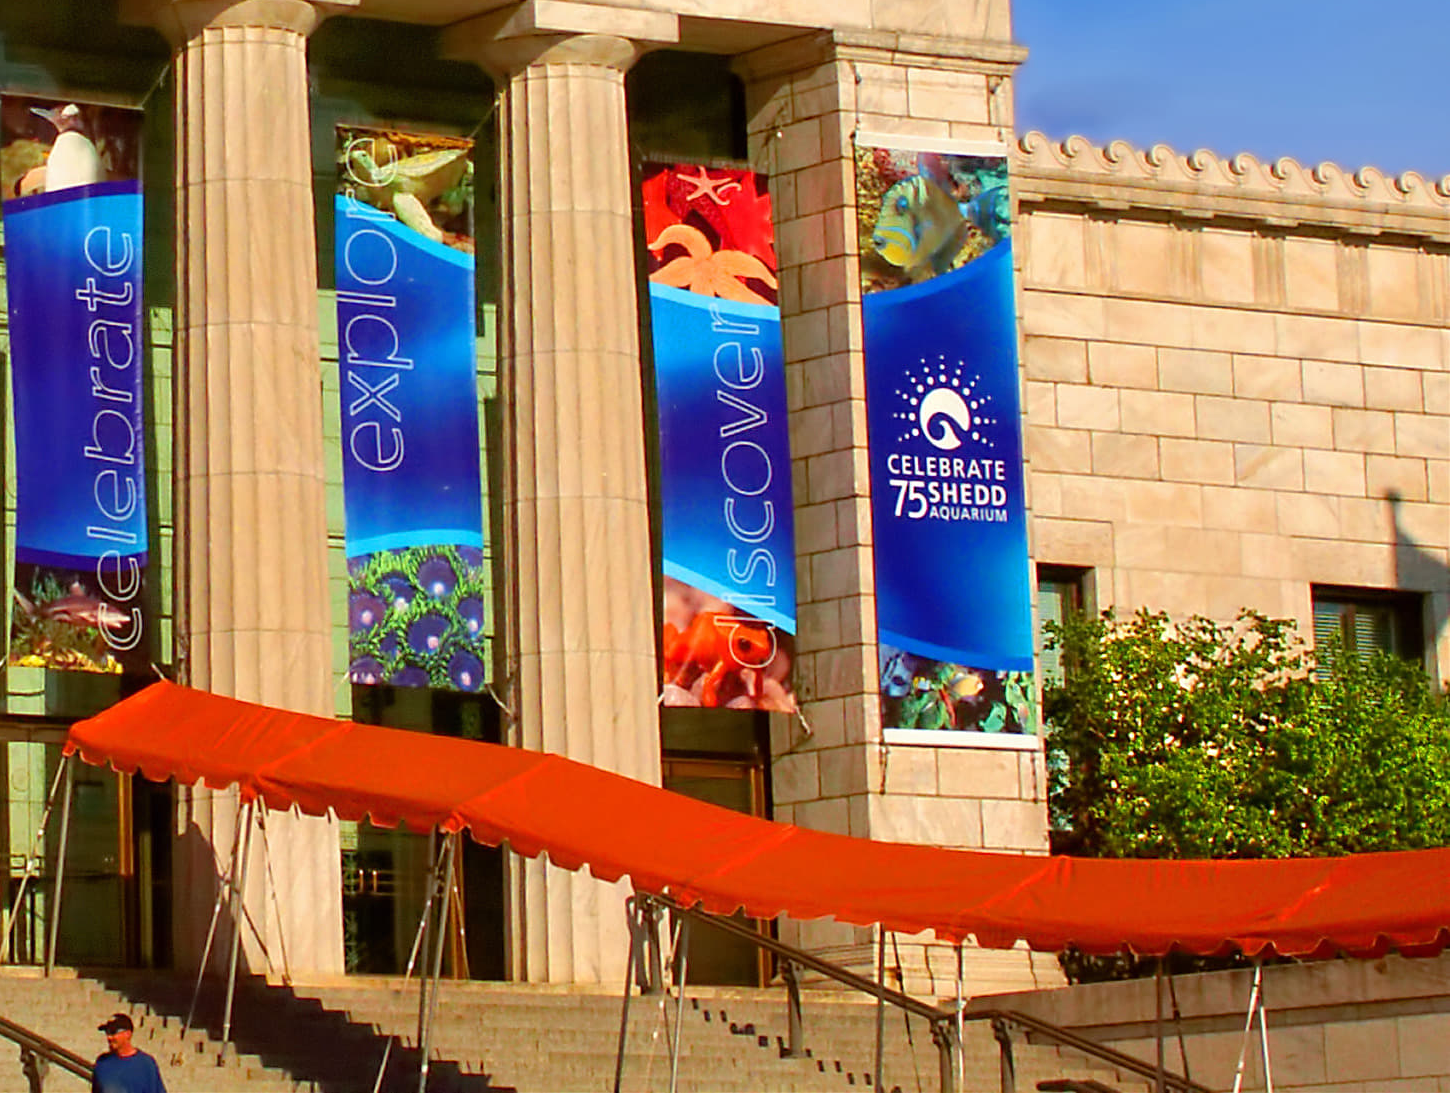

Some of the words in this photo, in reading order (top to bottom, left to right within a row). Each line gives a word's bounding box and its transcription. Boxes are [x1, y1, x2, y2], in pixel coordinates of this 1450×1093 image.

[336, 137, 413, 473] explore
[75, 226, 142, 651] celebrate
[713, 303, 777, 669] discover
[887, 453, 1006, 481] CELEBRATE
[889, 479, 929, 519] 75
[928, 481, 1007, 506] SHEDD
[929, 506, 1008, 522] AQUARIUM
